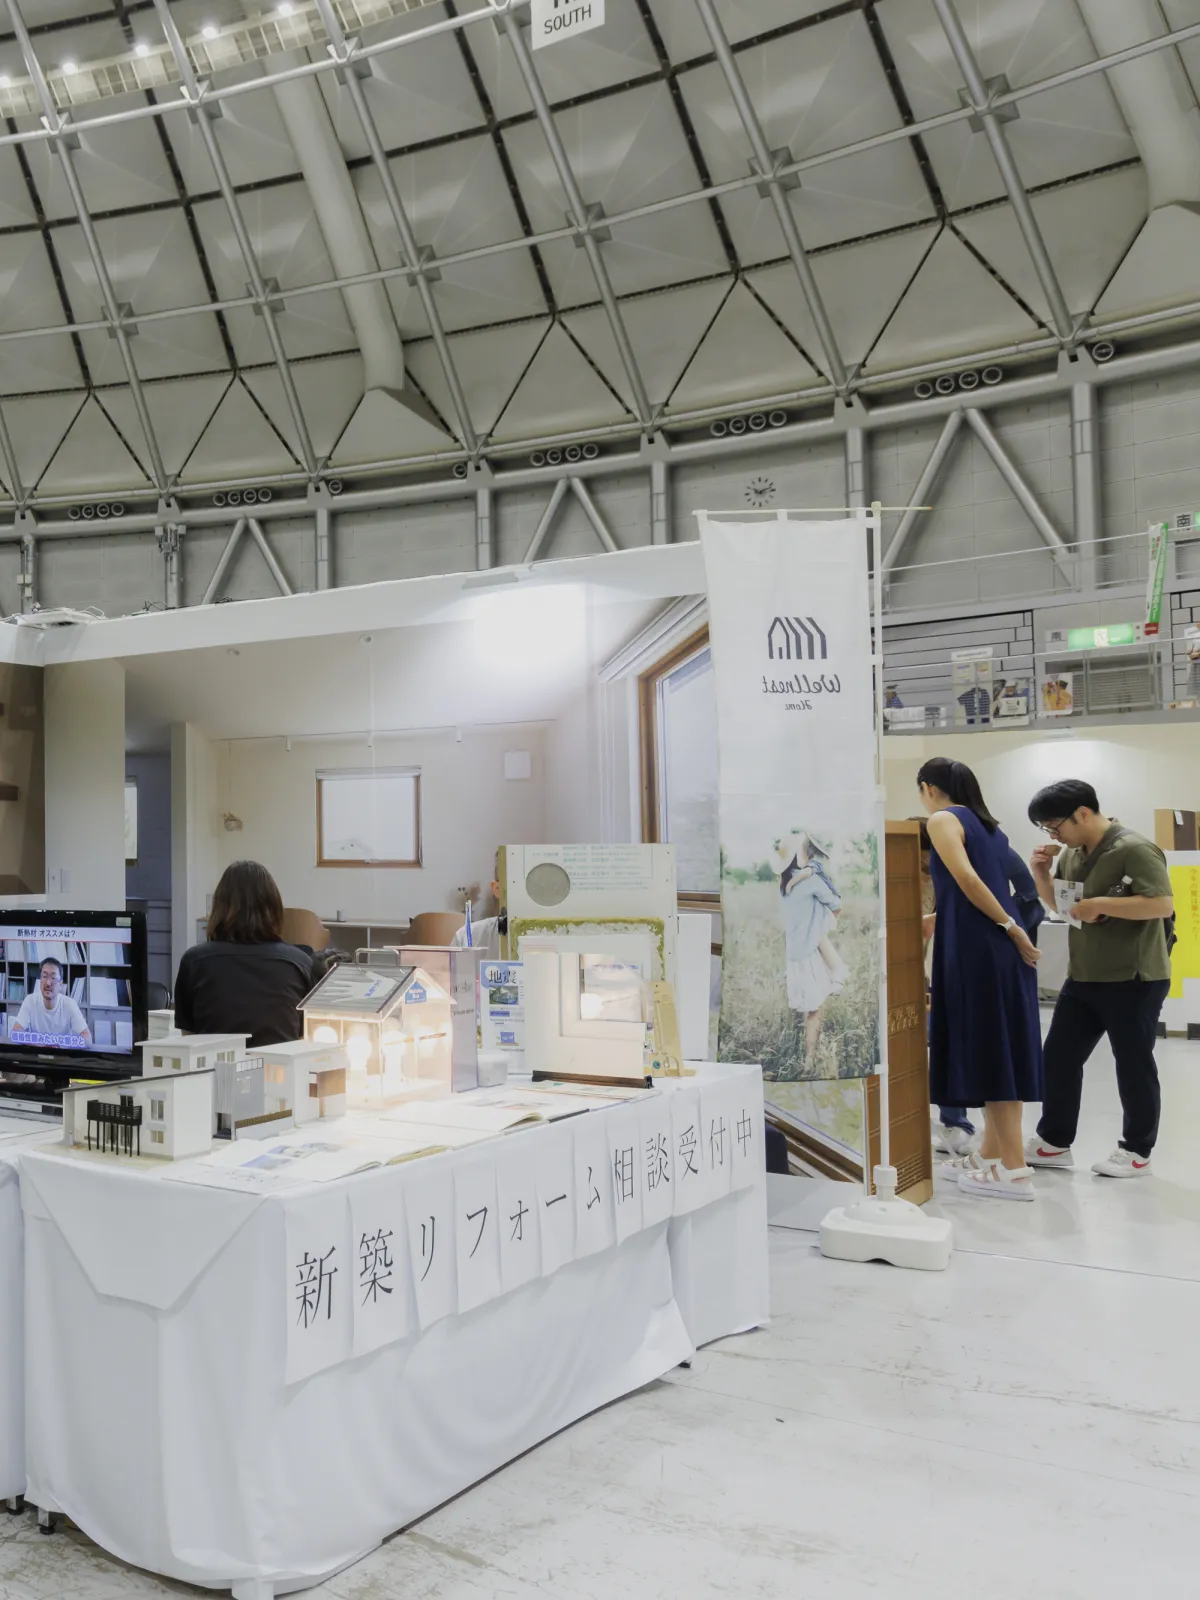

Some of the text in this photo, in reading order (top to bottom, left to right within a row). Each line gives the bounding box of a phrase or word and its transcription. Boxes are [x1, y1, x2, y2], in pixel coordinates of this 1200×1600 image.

[543, 4, 592, 35] SOUTH
[17, 929, 76, 938] 断熱材 オススメは？
[295, 1109, 753, 1329] 新築リフォーム相談受付中
